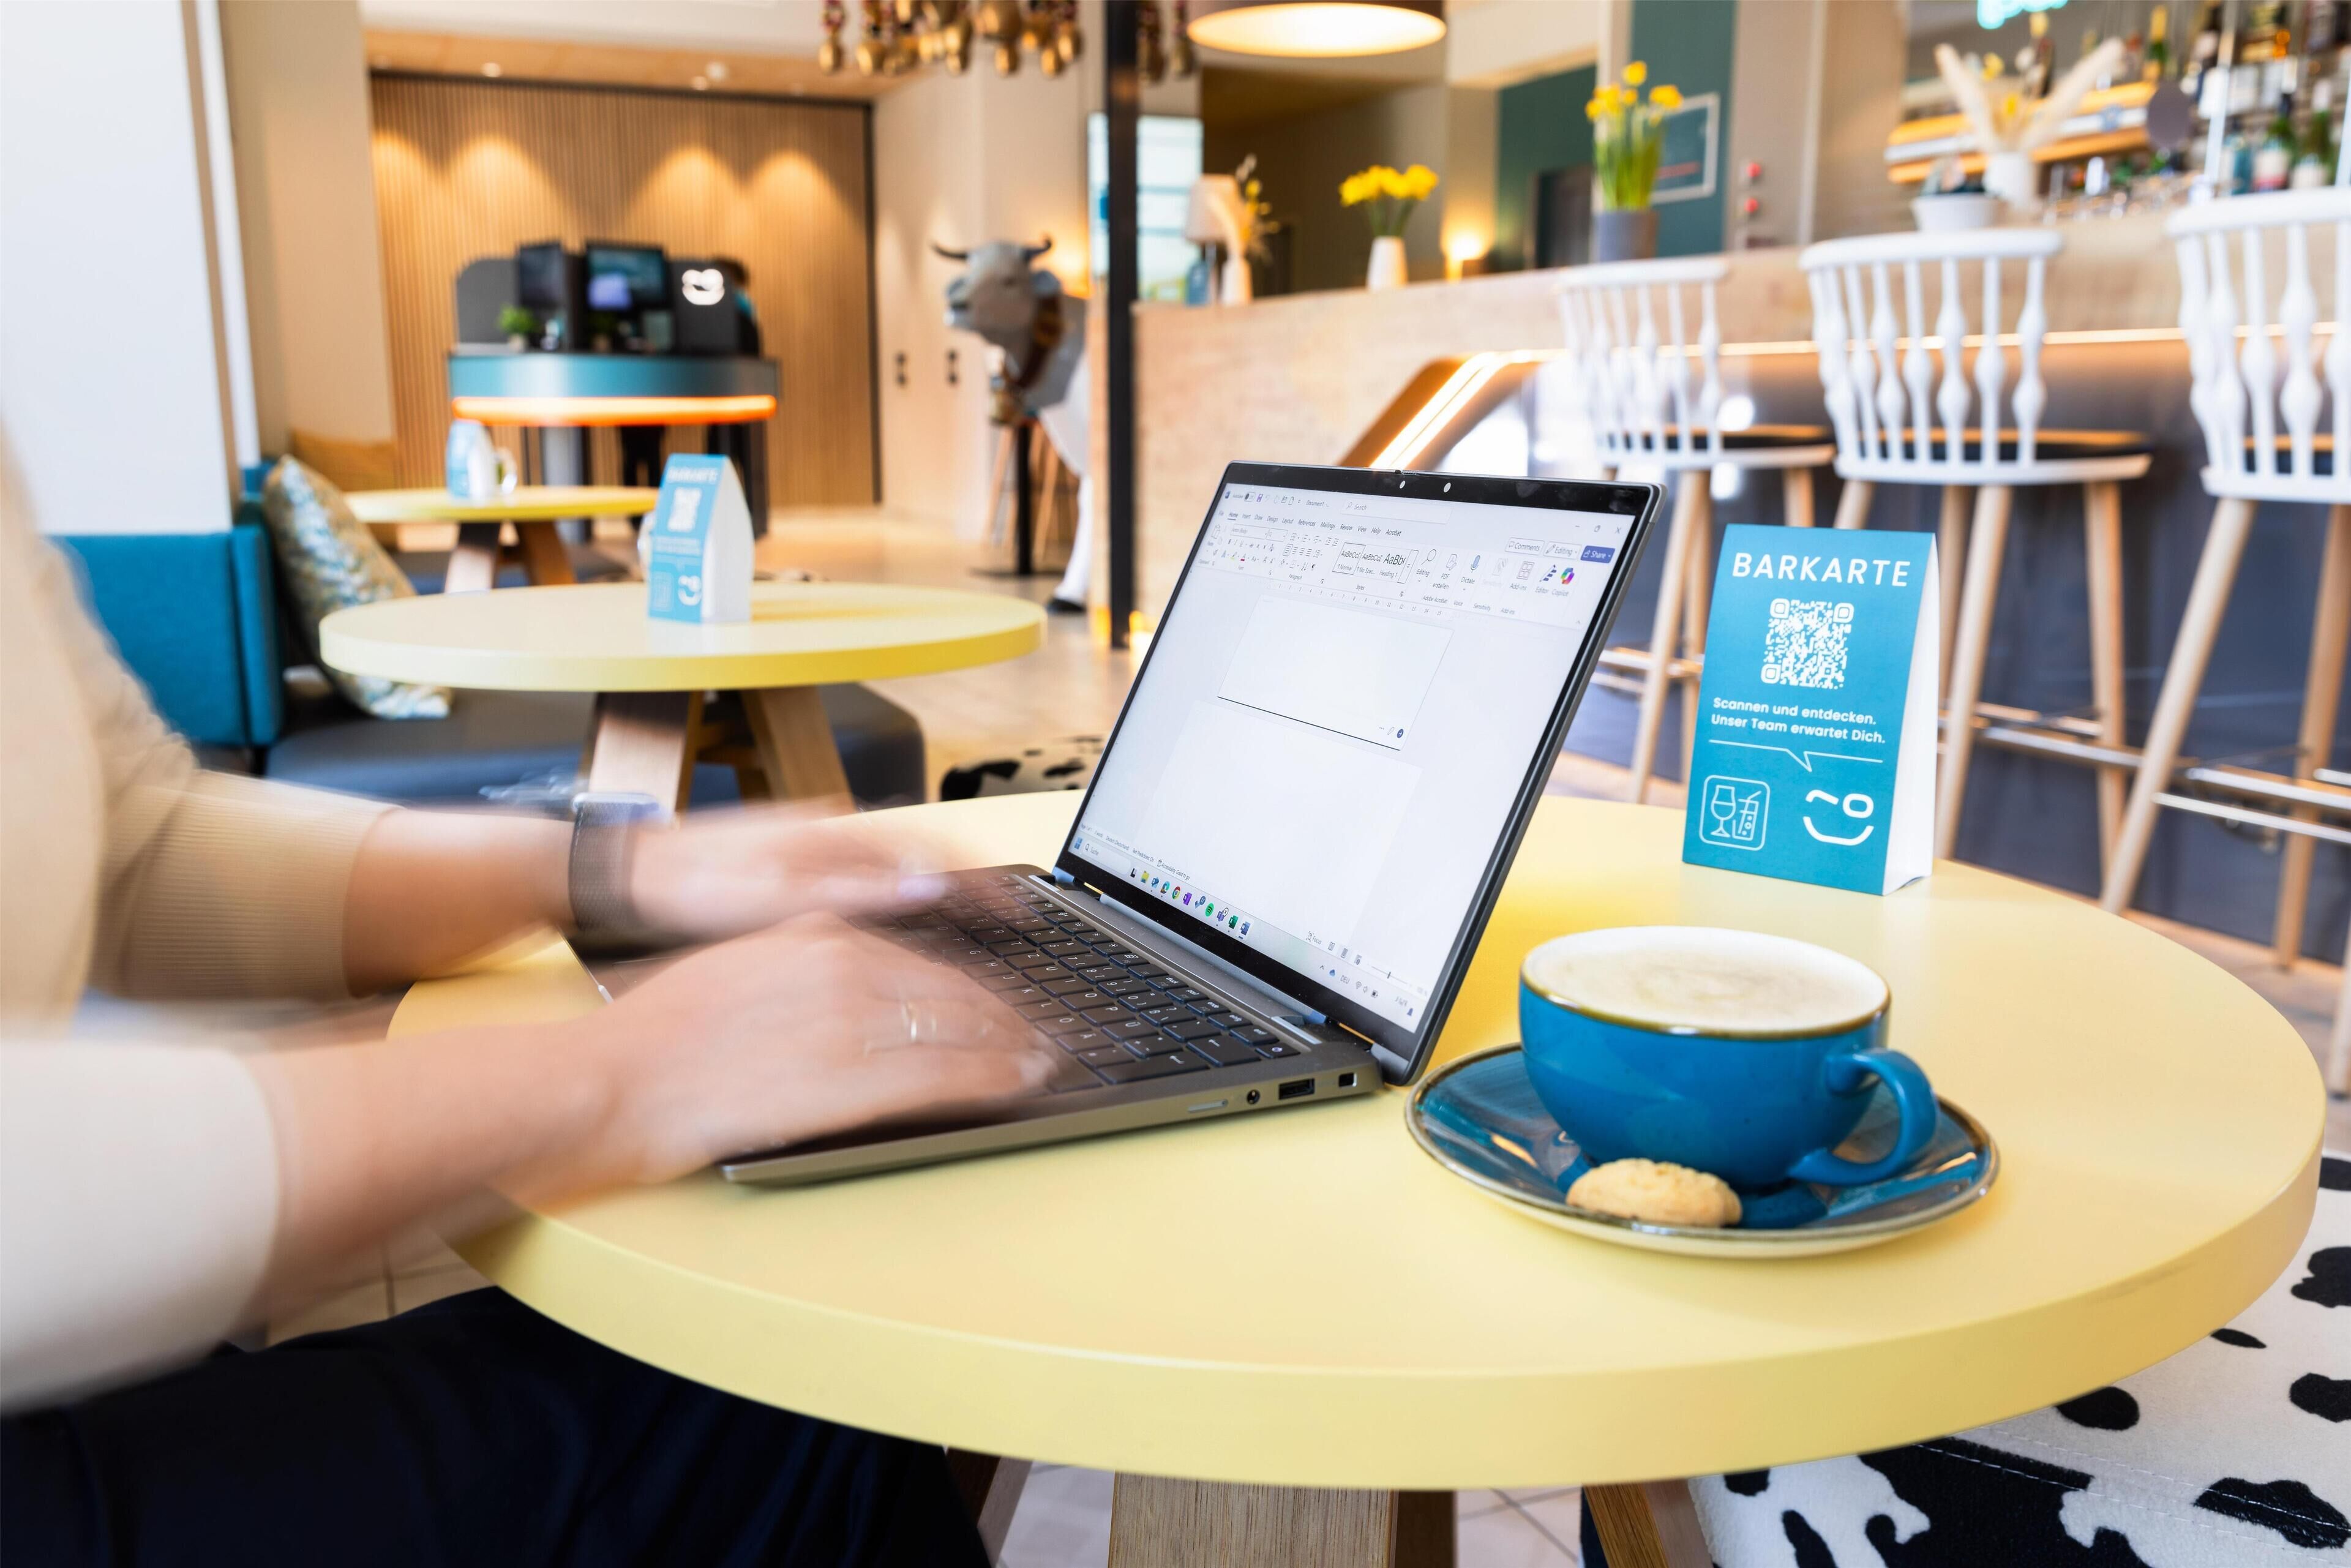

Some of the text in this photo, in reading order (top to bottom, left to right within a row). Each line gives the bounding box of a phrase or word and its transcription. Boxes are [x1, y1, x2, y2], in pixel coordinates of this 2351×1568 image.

[1514, 542, 1540, 551] Comments
[1554, 547, 1573, 556] Editing
[1416, 568, 1430, 577] Editing
[1732, 552, 1911, 588] BARKARTE
[1713, 696, 1877, 726] Scannen und entdecken.
[1711, 713, 1886, 745] Unser Team erwartet Dich.
[1312, 936, 1322, 945] Focus
[1340, 975, 1350, 985] DEU
